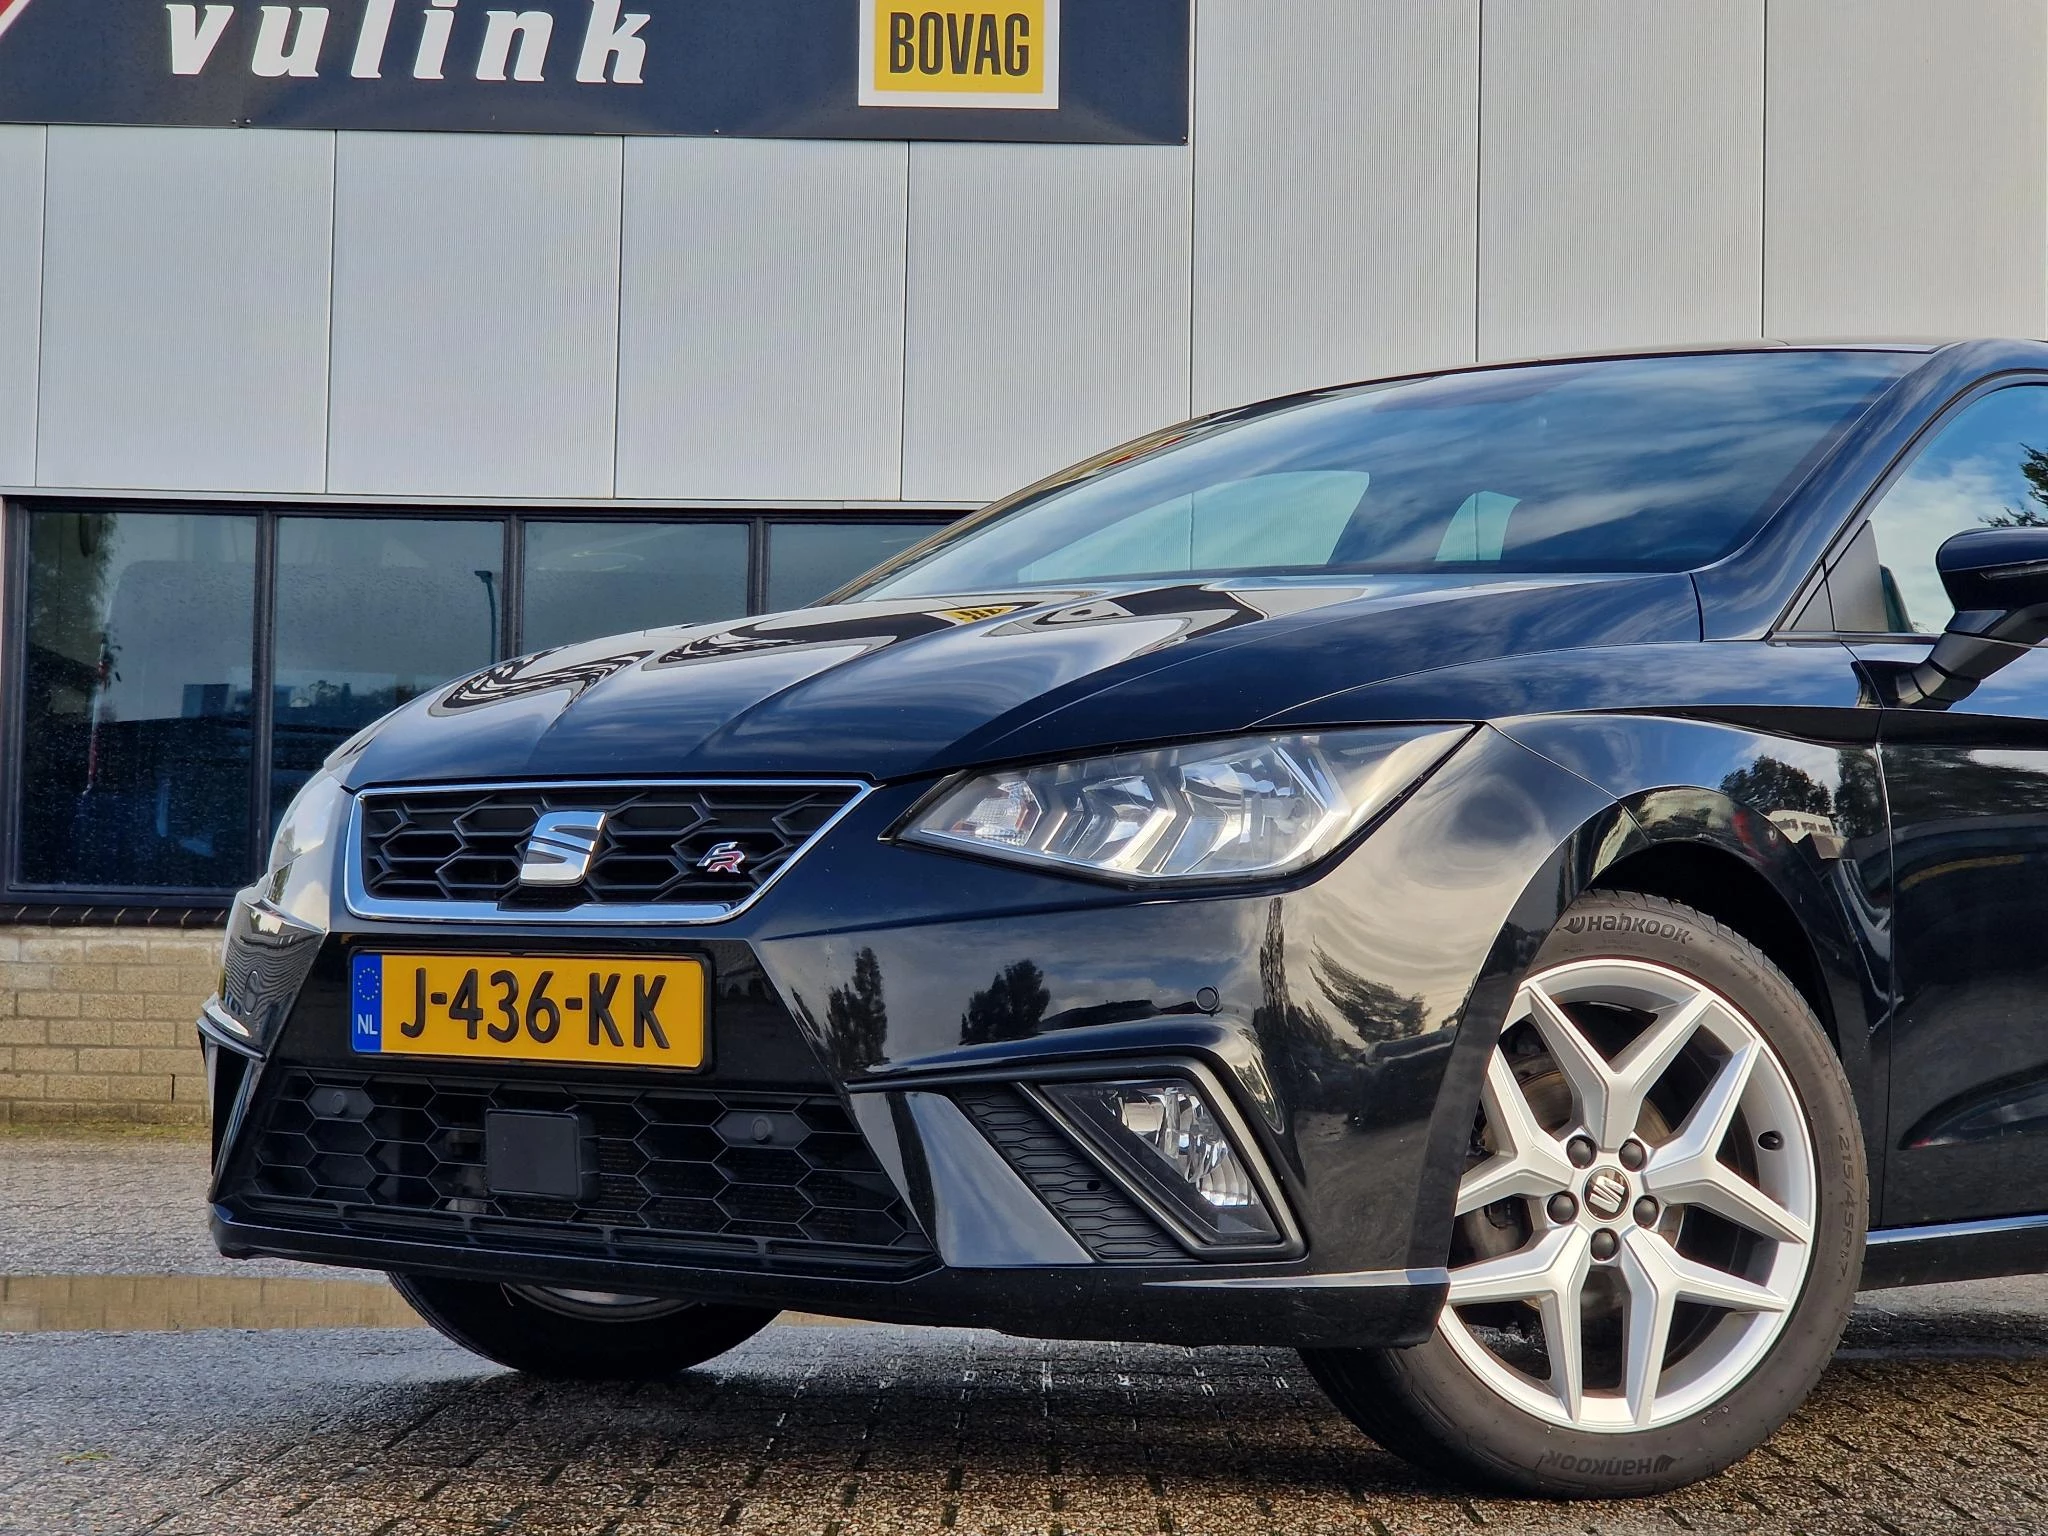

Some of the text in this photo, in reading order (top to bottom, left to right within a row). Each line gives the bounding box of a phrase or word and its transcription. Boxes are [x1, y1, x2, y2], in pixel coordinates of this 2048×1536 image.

[166, 0, 651, 84] vulink
[889, 12, 1030, 76] BOVAG
[696, 841, 746, 874] FR
[357, 1013, 378, 1035] NL
[400, 967, 670, 1049] J-436-KK
